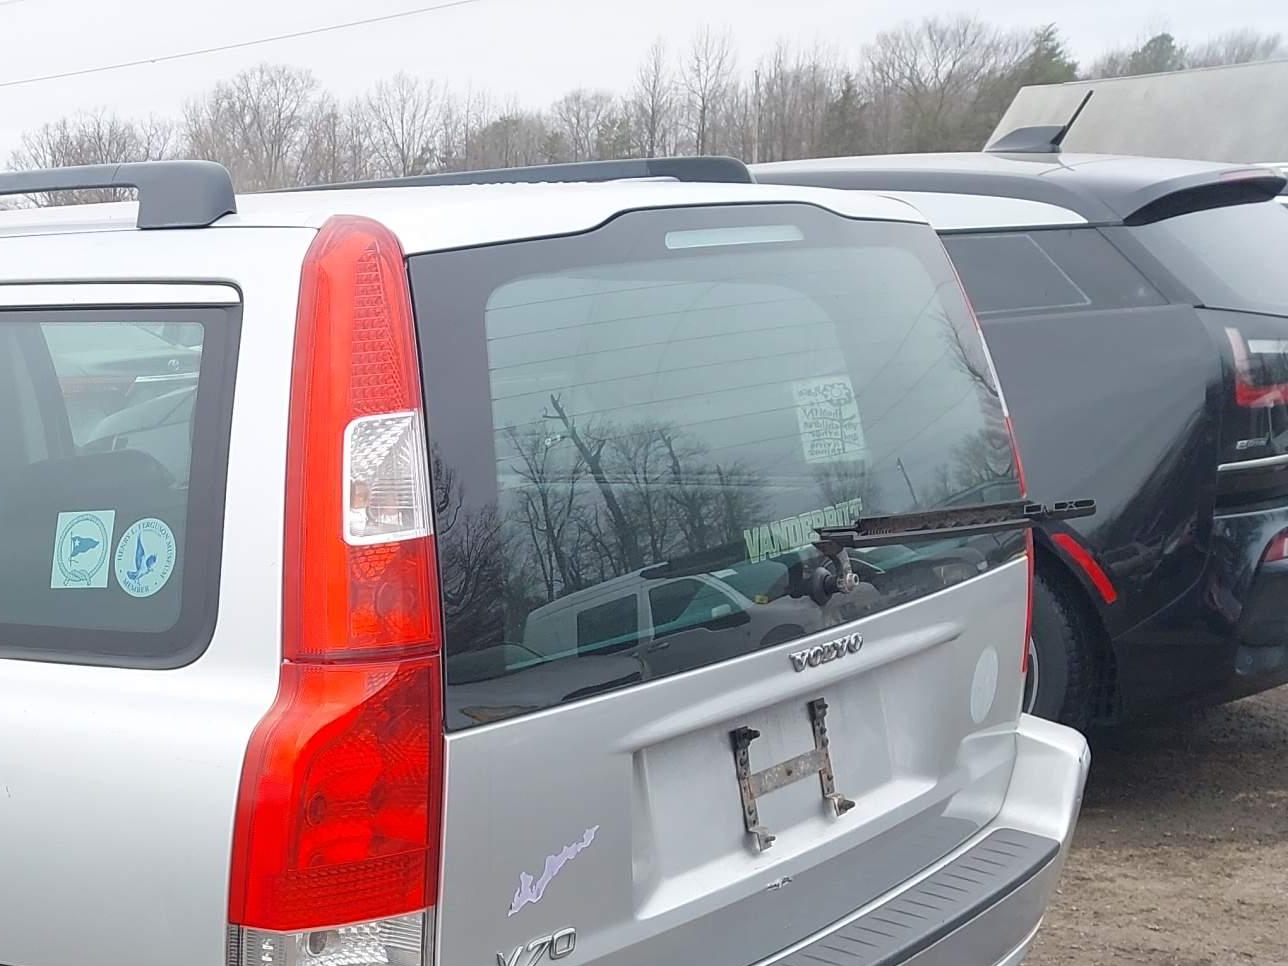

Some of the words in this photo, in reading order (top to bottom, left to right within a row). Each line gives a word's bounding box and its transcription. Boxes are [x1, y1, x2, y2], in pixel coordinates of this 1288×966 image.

[138, 521, 169, 540] FERGUSON
[123, 577, 150, 593] MEMBER
[789, 632, 864, 673] VOLVO
